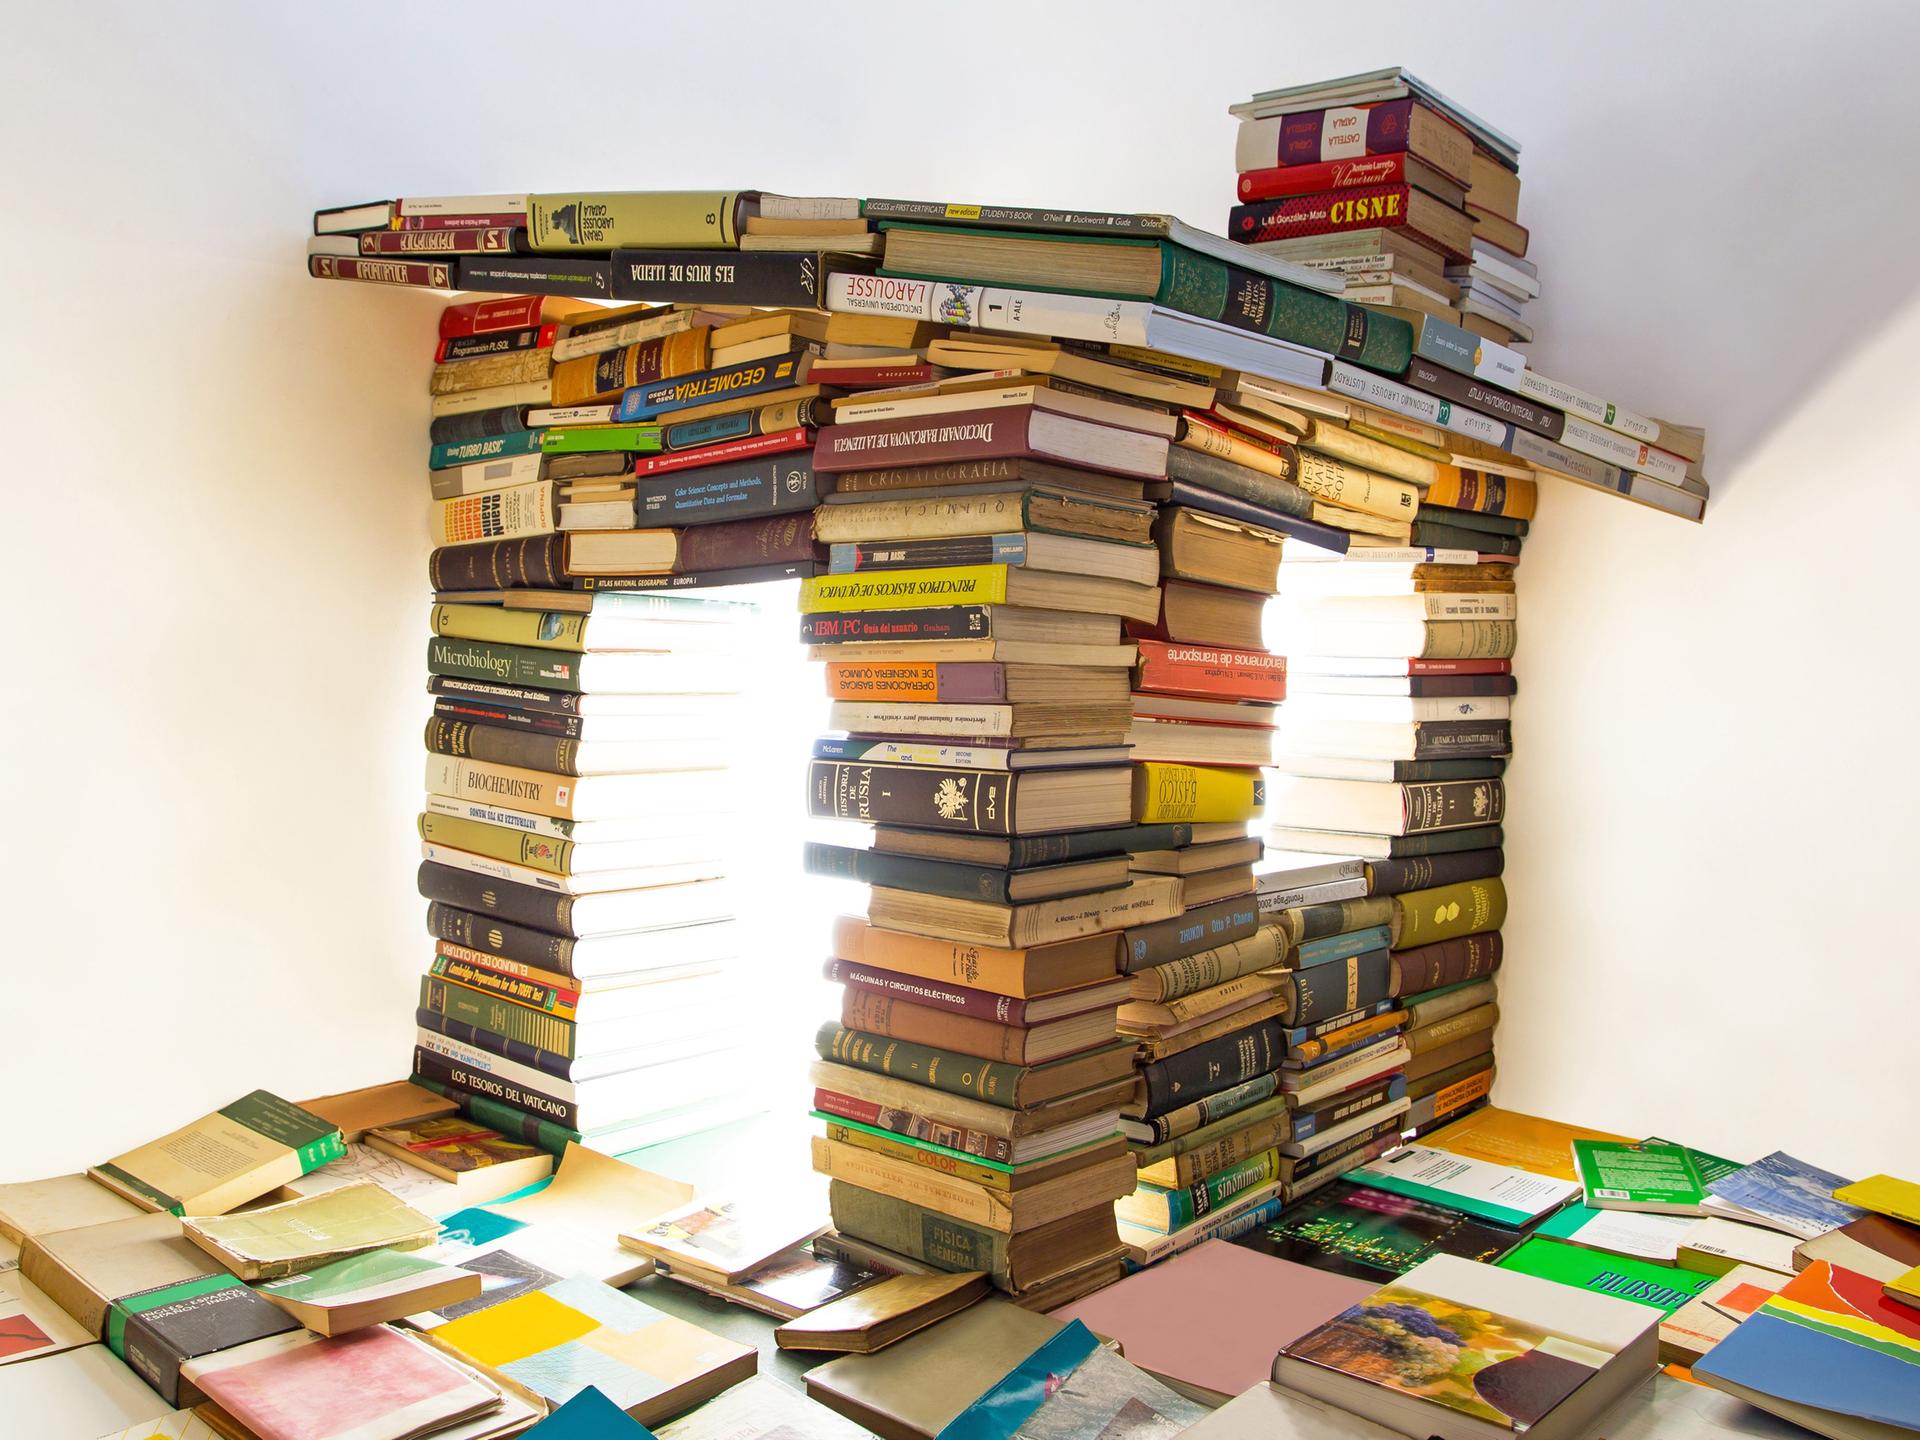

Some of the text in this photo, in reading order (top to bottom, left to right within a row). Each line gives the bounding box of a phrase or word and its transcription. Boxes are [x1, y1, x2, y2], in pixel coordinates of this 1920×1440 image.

[1352, 160, 1394, 172] Antonio Larreta
[866, 202, 945, 215] SUCCESS FIRST CERTIFICATE
[949, 207, 978, 216] new edition
[981, 209, 1033, 220] STUDENT'S BOOK
[1330, 194, 1401, 224] CISNE
[583, 218, 614, 229] LAROUSSE
[1043, 213, 1163, 228] O'Neill Duckworth Gude Oxford
[1277, 210, 1327, 224] González-Mata
[584, 230, 603, 241] GRAN
[356, 262, 408, 282] INFORMATICA
[631, 264, 734, 283] ELS RIUS DE LLEIDA
[847, 277, 926, 303] LAROUSSE
[847, 297, 923, 315] ENCICLOPEDIA UNIVERSAL
[1241, 280, 1253, 317] MUNDO
[1013, 299, 1023, 322] A-ALE
[452, 345, 489, 356] Programación
[674, 366, 766, 402] GEOMETRÍA
[648, 390, 668, 400] paso
[655, 394, 675, 404] paso
[834, 422, 993, 453] DICCIONARI BARCANOVA DE LA LLENGUA
[458, 440, 504, 453] TURBO BASIC
[675, 487, 687, 497] Color
[707, 483, 728, 493] Concepts
[729, 481, 739, 489] and
[675, 493, 748, 509] Quantitative Data and Formulae
[903, 500, 1005, 517] QUIMICA
[613, 579, 638, 587] NATIONAL
[638, 578, 668, 586] GEOGRAPHIC
[673, 578, 693, 586] EUROPA
[818, 579, 976, 600] PRINCIPIOS BÁSICOS DE QUÍMICA
[815, 619, 839, 635] IBM
[843, 620, 861, 635] PC
[880, 623, 891, 633] del
[892, 622, 918, 632] usuario
[434, 645, 512, 678] Microbiology
[1167, 648, 1218, 665] transporte
[1219, 654, 1232, 667] de
[839, 669, 934, 679] DE INGENIERIA QUIMICA
[840, 680, 935, 690] OPERACIONES BASICAS
[524, 691, 532, 700] 2nd
[532, 692, 550, 702] Edition
[901, 754, 913, 762] and
[940, 748, 947, 756] of
[468, 771, 543, 801] BIOCHEMISTRY
[841, 767, 850, 817] HISTORIA
[850, 785, 856, 800] DE
[858, 767, 872, 819] RUSIA
[1159, 780, 1197, 803] BÁSICO
[1435, 786, 1443, 827] RUSIA
[497, 814, 504, 823] EN
[504, 817, 537, 830] NATURALEZA
[1257, 894, 1305, 910] FrontPage 2000
[1179, 924, 1204, 945] ZHUKOV
[1211, 919, 1225, 933] Otto
[443, 944, 528, 976] EL MUNDO DE LA CULTURA
[448, 962, 544, 1001] Cambridge Preparation for the Test
[850, 972, 884, 987] MÁQUINAS
[889, 980, 924, 996] CIRCUITOS
[924, 987, 966, 1005] ELÉCTRICOS
[451, 1069, 566, 1118] LOS TESOROS DEL VATICANO
[917, 1151, 957, 1172] COLOR
[1217, 1163, 1265, 1201] sinónimos
